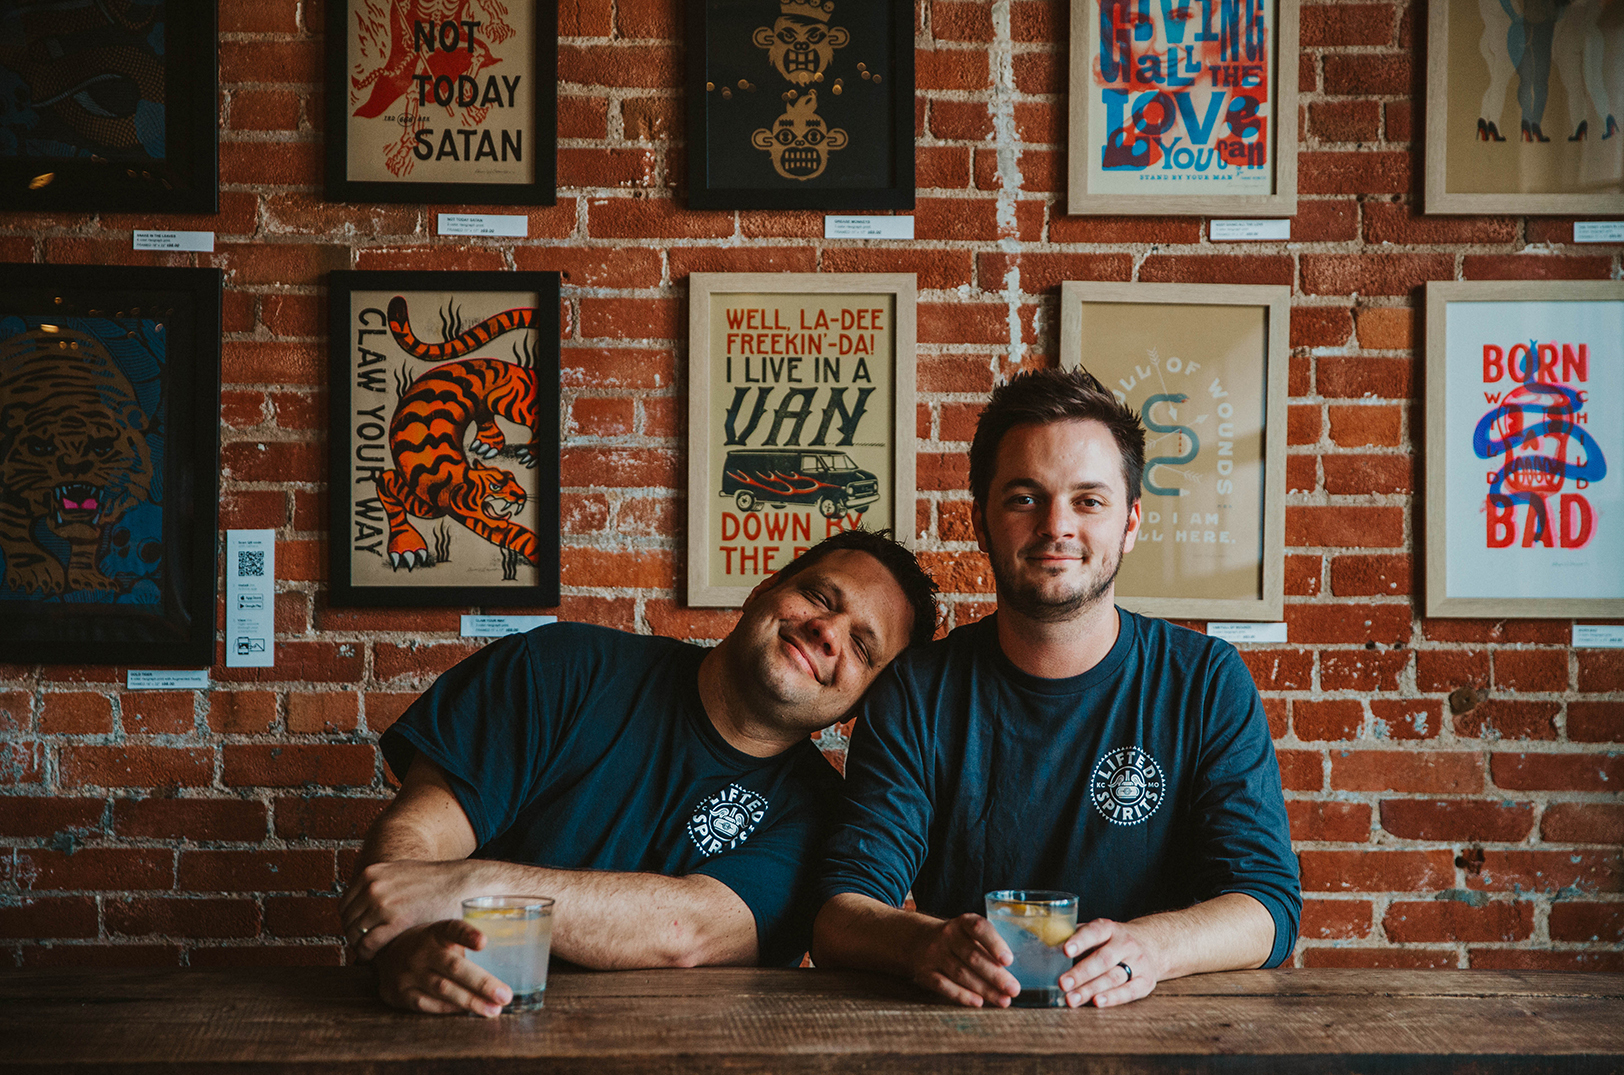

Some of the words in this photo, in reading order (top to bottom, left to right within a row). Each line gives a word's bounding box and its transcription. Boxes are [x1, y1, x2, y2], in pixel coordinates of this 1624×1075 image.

[414, 20, 481, 53] NOT
[412, 74, 522, 108] TODAY
[1208, 65, 1264, 87] THE
[413, 128, 522, 162] SATAN
[1152, 136, 1214, 172] YOU
[726, 308, 791, 332] WELL,
[800, 308, 884, 330] LA-DEE
[357, 307, 387, 393] CLAW
[726, 332, 875, 355] FREEKIN'-DA!
[726, 357, 732, 383] I
[745, 357, 802, 383] LIVE
[815, 357, 840, 383] IN
[851, 357, 872, 383] A
[1482, 343, 1589, 384] BORN
[723, 386, 877, 447] VAN
[1113, 364, 1152, 405] ULL
[1166, 356, 1201, 376] OF
[1208, 377, 1234, 495] WOUNDS
[355, 404, 385, 485] YOUR
[354, 497, 384, 558] WAY
[721, 512, 811, 542] DOWN
[1173, 512, 1178, 524] I
[1190, 512, 1219, 525] AM
[1486, 493, 1595, 549] BAD
[1175, 530, 1236, 544] HERE.
[720, 546, 780, 575] THE
[1098, 751, 1156, 780] LIFTED
[1096, 790, 1158, 820] SPIRITS
